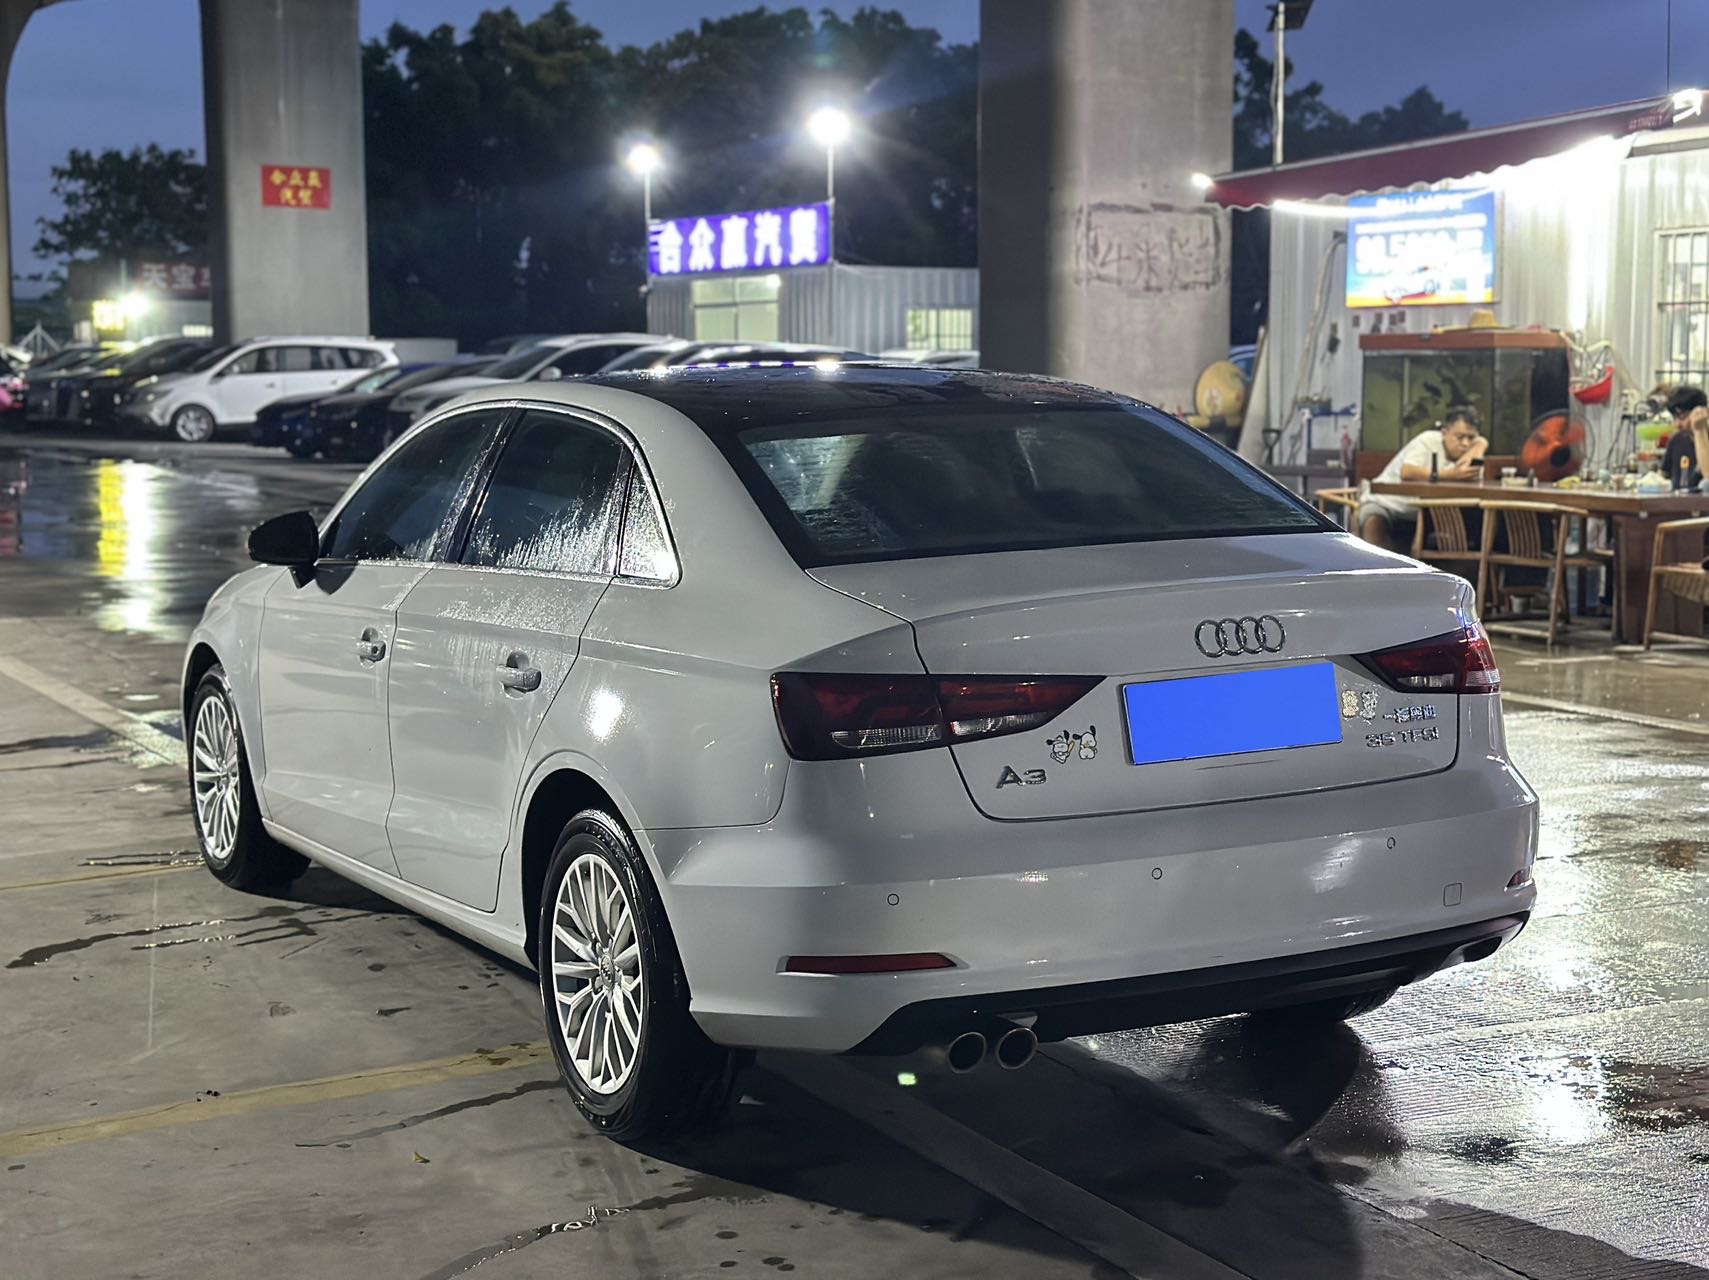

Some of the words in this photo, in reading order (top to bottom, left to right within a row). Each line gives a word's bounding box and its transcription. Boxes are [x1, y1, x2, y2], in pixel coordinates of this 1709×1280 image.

[1365, 731, 1396, 748] 35
[1398, 726, 1440, 743] TFSI
[996, 766, 1047, 789] A3
